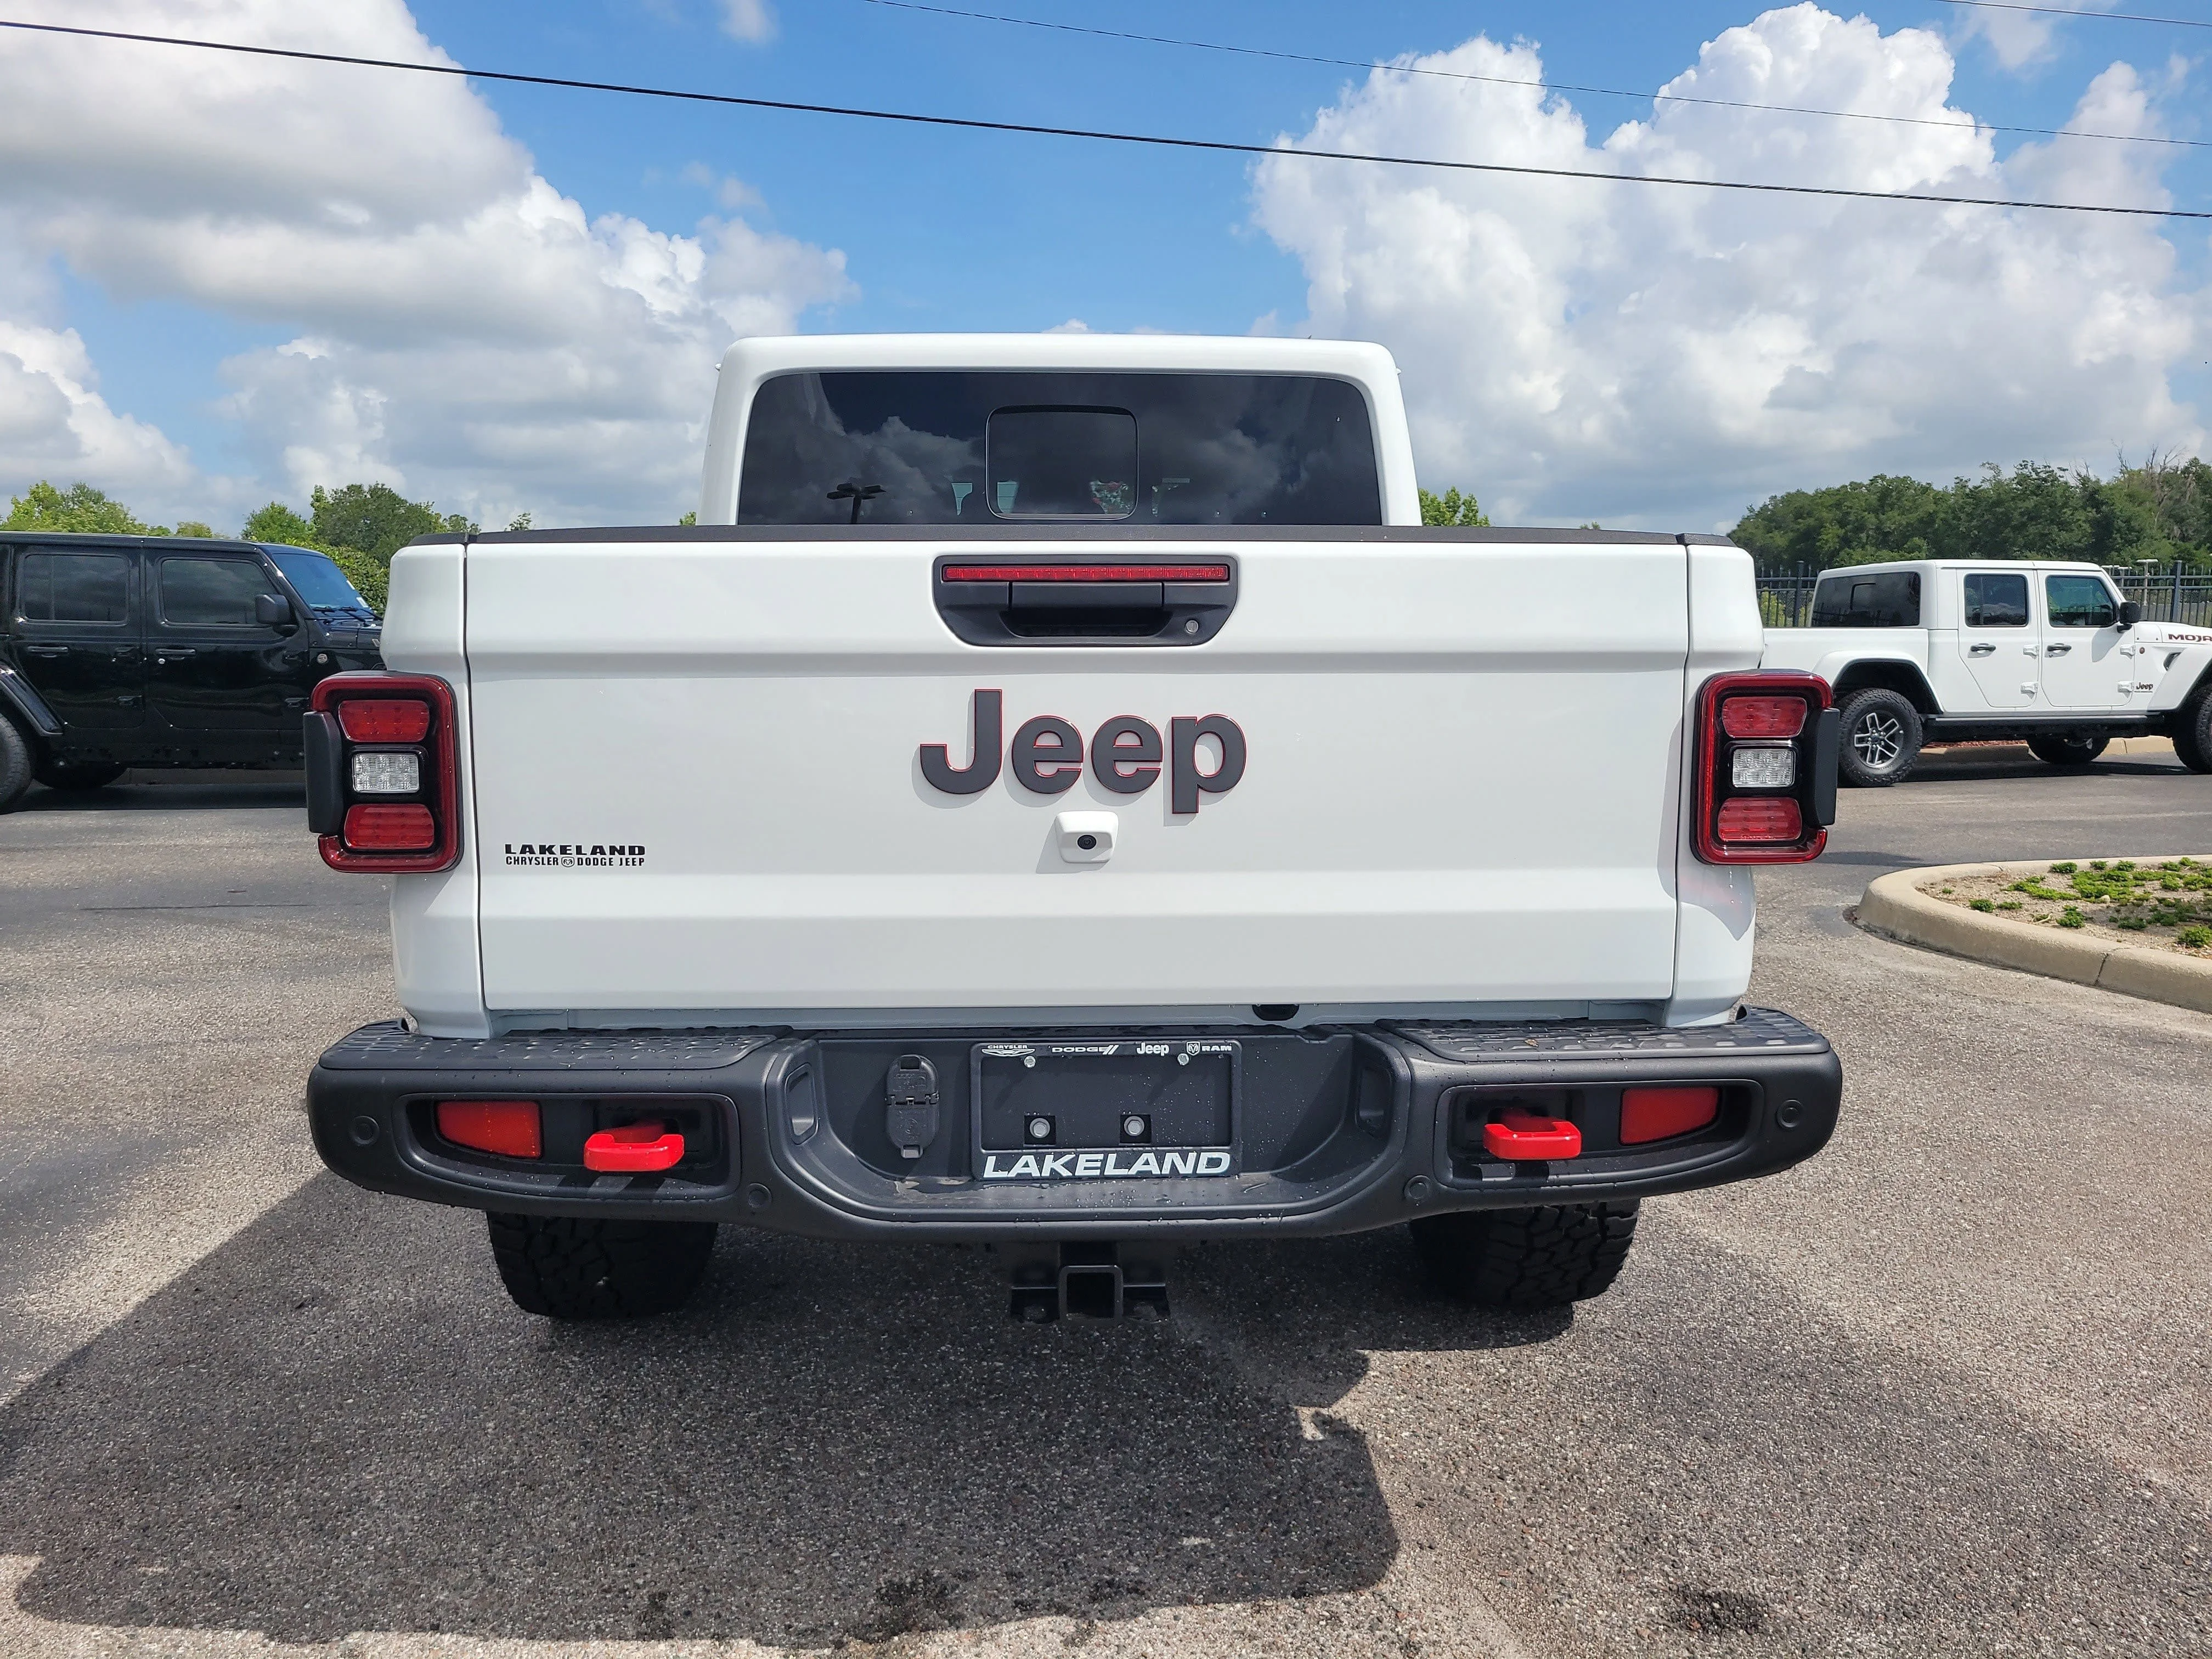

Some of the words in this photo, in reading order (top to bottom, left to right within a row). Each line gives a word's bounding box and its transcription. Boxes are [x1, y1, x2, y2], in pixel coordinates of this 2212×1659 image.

[2136, 682, 2153, 690] Jeep
[919, 689, 1247, 814] Jeep
[505, 844, 645, 855] LAKELAND
[506, 856, 558, 865] CHRYSLER
[578, 857, 613, 866] DODGE
[1137, 1042, 1169, 1056] Jeep
[983, 1152, 1231, 1177] LAKELAND
